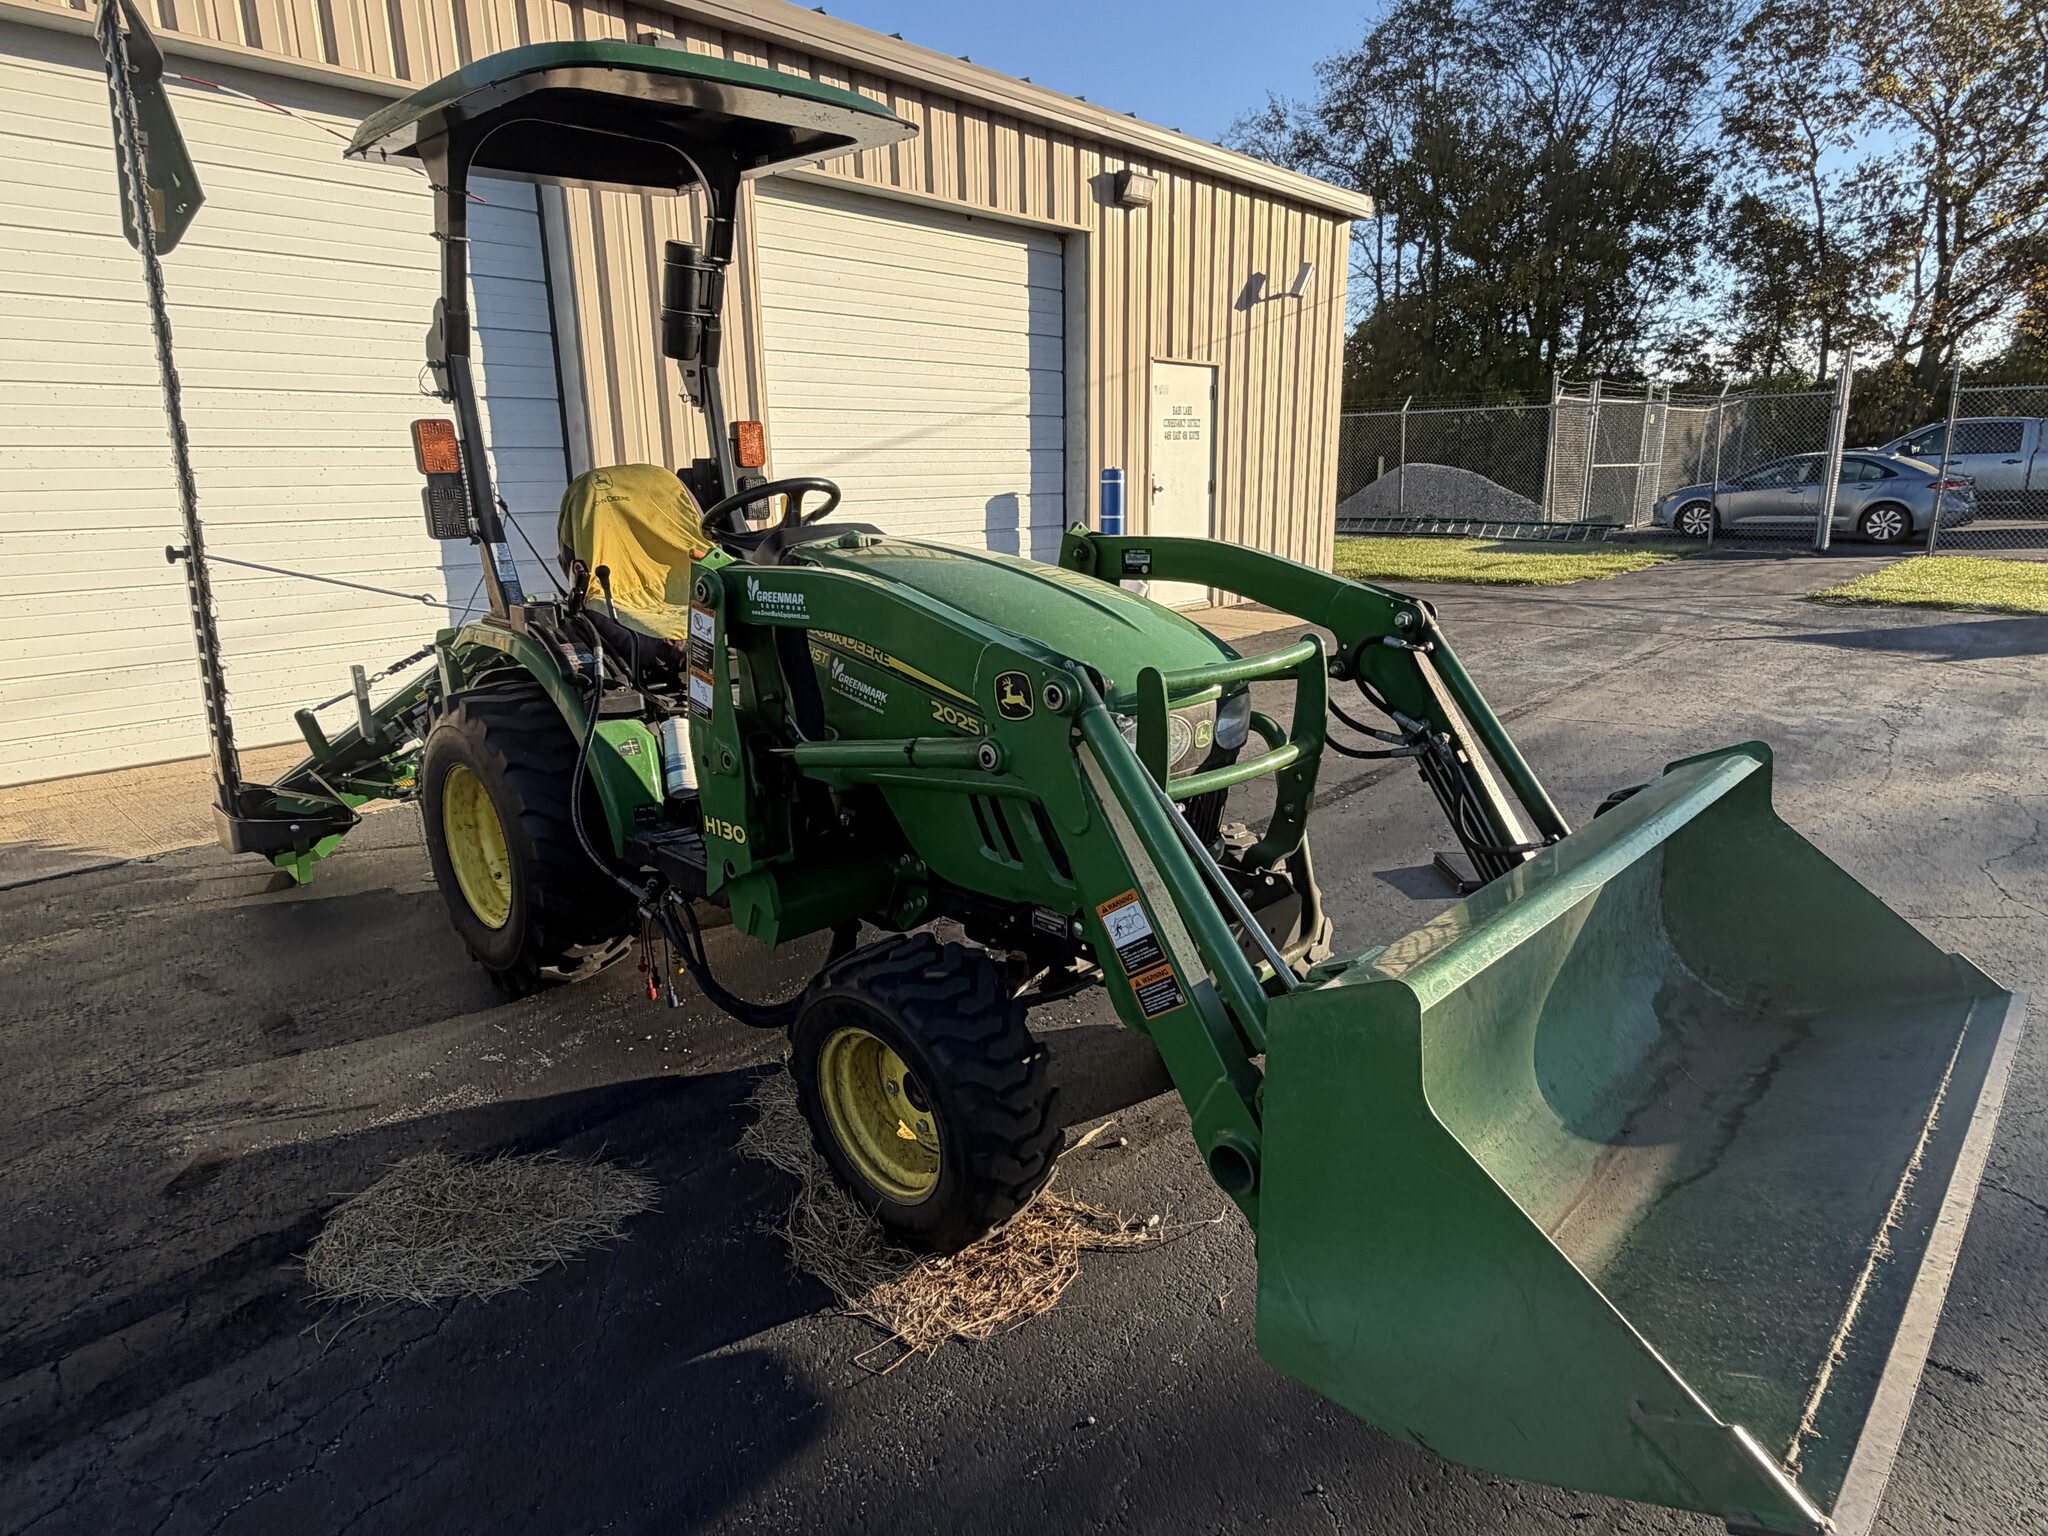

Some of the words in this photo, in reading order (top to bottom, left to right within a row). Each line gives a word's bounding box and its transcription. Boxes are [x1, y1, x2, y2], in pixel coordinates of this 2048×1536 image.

[760, 602, 807, 612] EQUIPMENT
[838, 673, 888, 703] GREENMARK
[840, 684, 883, 706] EQUIPMENT
[705, 815, 746, 844] H130
[1107, 893, 1134, 910] WARNING
[1141, 968, 1169, 984] WARNING
